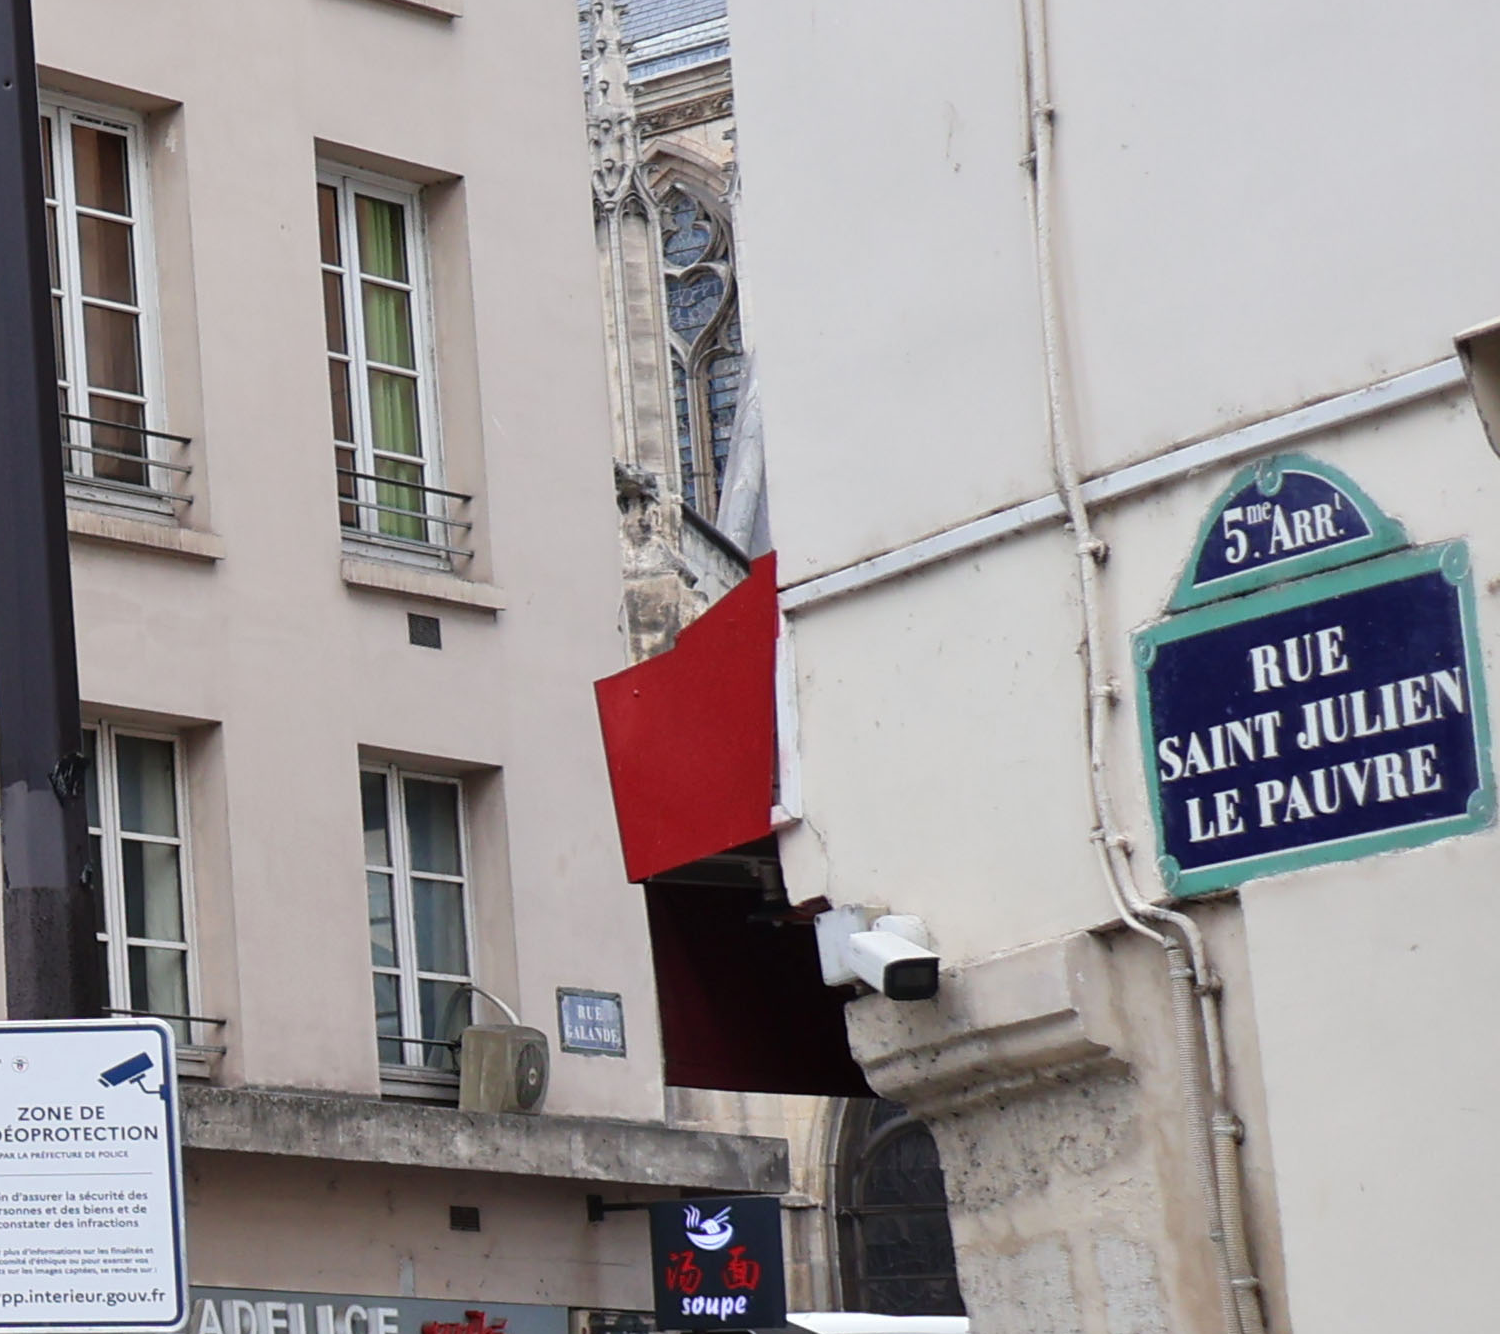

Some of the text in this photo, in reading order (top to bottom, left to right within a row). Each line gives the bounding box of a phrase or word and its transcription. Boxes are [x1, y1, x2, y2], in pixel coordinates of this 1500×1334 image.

[1249, 625, 1348, 693] RUE
[1158, 666, 1468, 783] SAINT JULIEN
[1186, 743, 1443, 844] LE PAUVRE
[577, 1005, 603, 1020] RUE
[564, 1024, 620, 1044] GALANDE
[18, 1106, 105, 1121] ZONE DE
[0, 1152, 16, 1160] PAR
[31, 1150, 82, 1159] PRÉFECTURE
[85, 1151, 96, 1159] DE
[98, 1150, 129, 1158] POLICE
[12, 1191, 62, 1202] d'assurer
[66, 1191, 76, 1201] la
[79, 1191, 125, 1201] sécurité
[127, 1191, 148, 1200] des
[45, 1206, 56, 1215] et
[60, 1205, 80, 1214] des
[84, 1205, 114, 1214] biens
[118, 1205, 129, 1214] et
[132, 1204, 147, 1213] de
[54, 1219, 74, 1229] des
[77, 1218, 138, 1228] infractions
[681, 1295, 747, 1322] soupe
